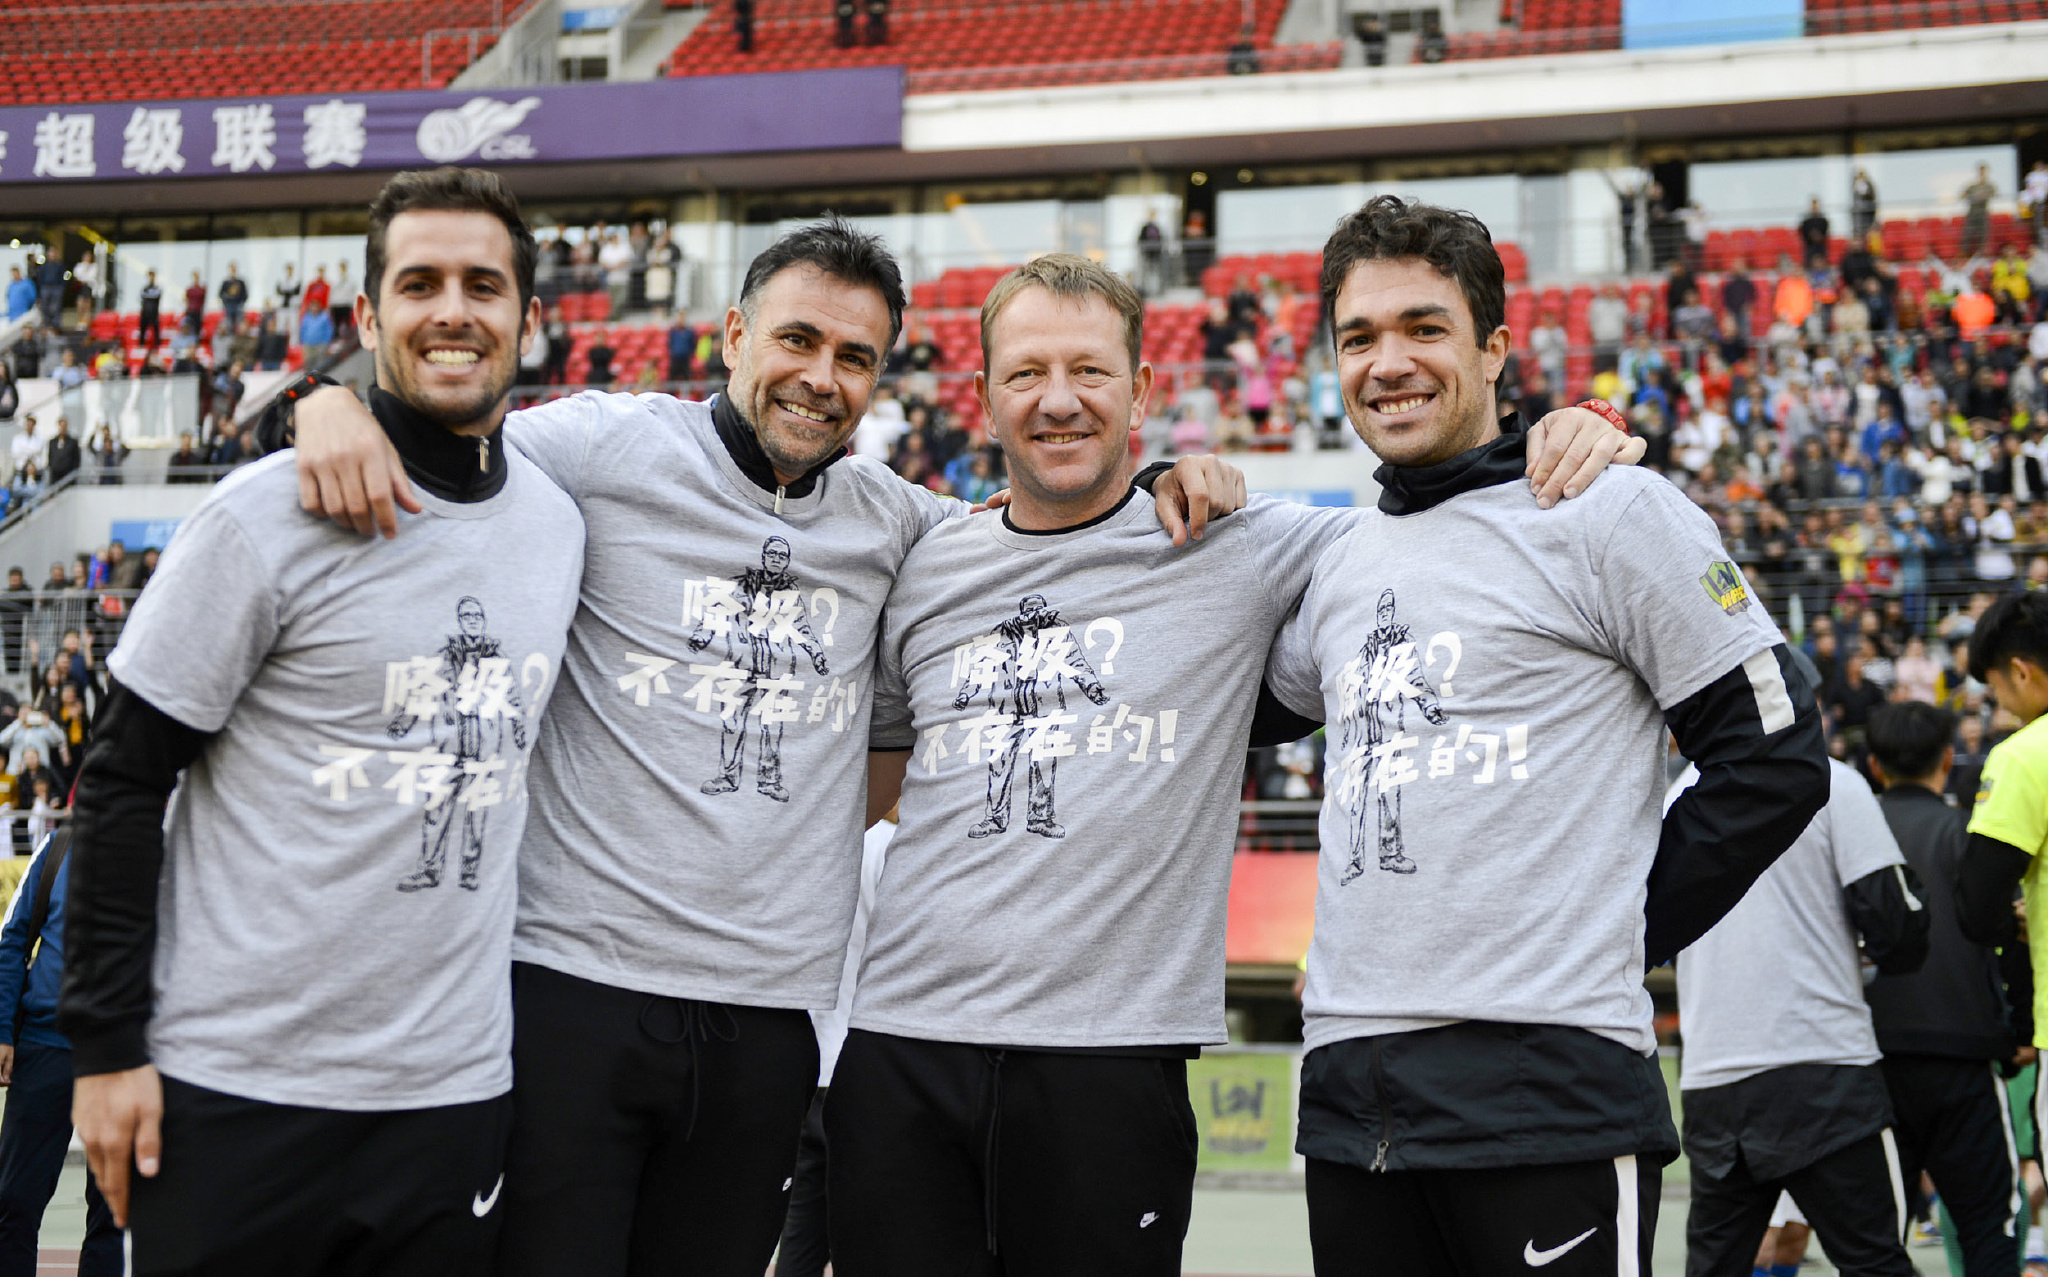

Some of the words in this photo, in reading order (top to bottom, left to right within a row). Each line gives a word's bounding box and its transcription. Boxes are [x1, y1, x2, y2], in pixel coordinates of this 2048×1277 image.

[0, 99, 368, 177] 超级联赛
[479, 134, 538, 160] CSL
[681, 576, 839, 647] 降级?
[381, 653, 549, 721] 降级?
[950, 617, 1124, 689] 降级?
[922, 703, 1178, 775] 不存在的!
